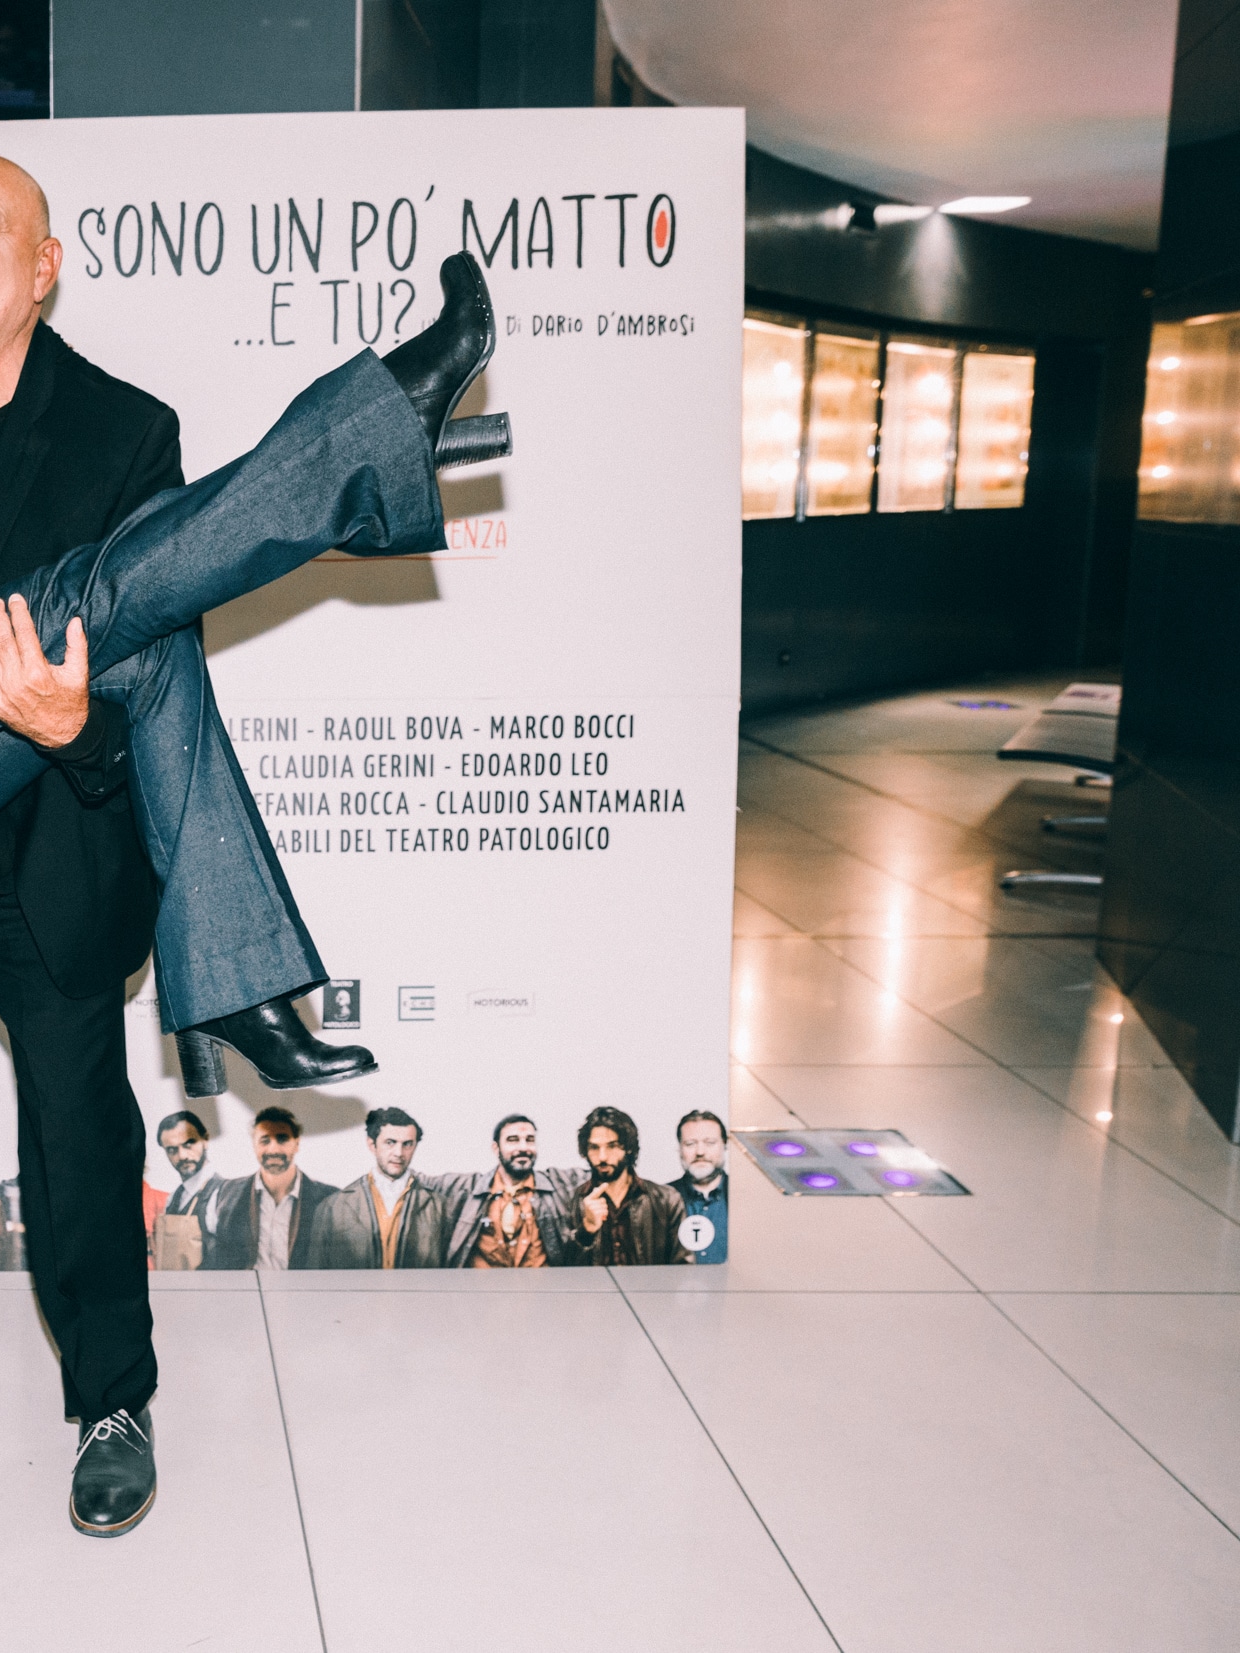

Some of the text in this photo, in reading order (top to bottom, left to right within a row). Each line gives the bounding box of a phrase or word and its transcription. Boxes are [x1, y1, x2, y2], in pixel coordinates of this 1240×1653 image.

[77, 184, 677, 280] SONO UN PO' MATTO
[319, 277, 416, 345] TU?
[323, 716, 397, 742] RAOUL
[406, 715, 464, 741] BOVA
[490, 714, 565, 740] MARCO
[573, 713, 635, 740] BOCCI
[259, 754, 355, 780] CLAUDIA
[363, 753, 435, 779] GERINI
[461, 751, 562, 778] EDOARDO
[571, 751, 609, 777] LEO
[340, 790, 410, 816] ROCCA
[435, 789, 530, 816] CLAUDIO
[538, 788, 686, 814] SANTAMARIA
[273, 825, 610, 854] ABILI DEL TEATRO PATOLOGICO
[472, 997, 529, 1008] NOTORIOUS
